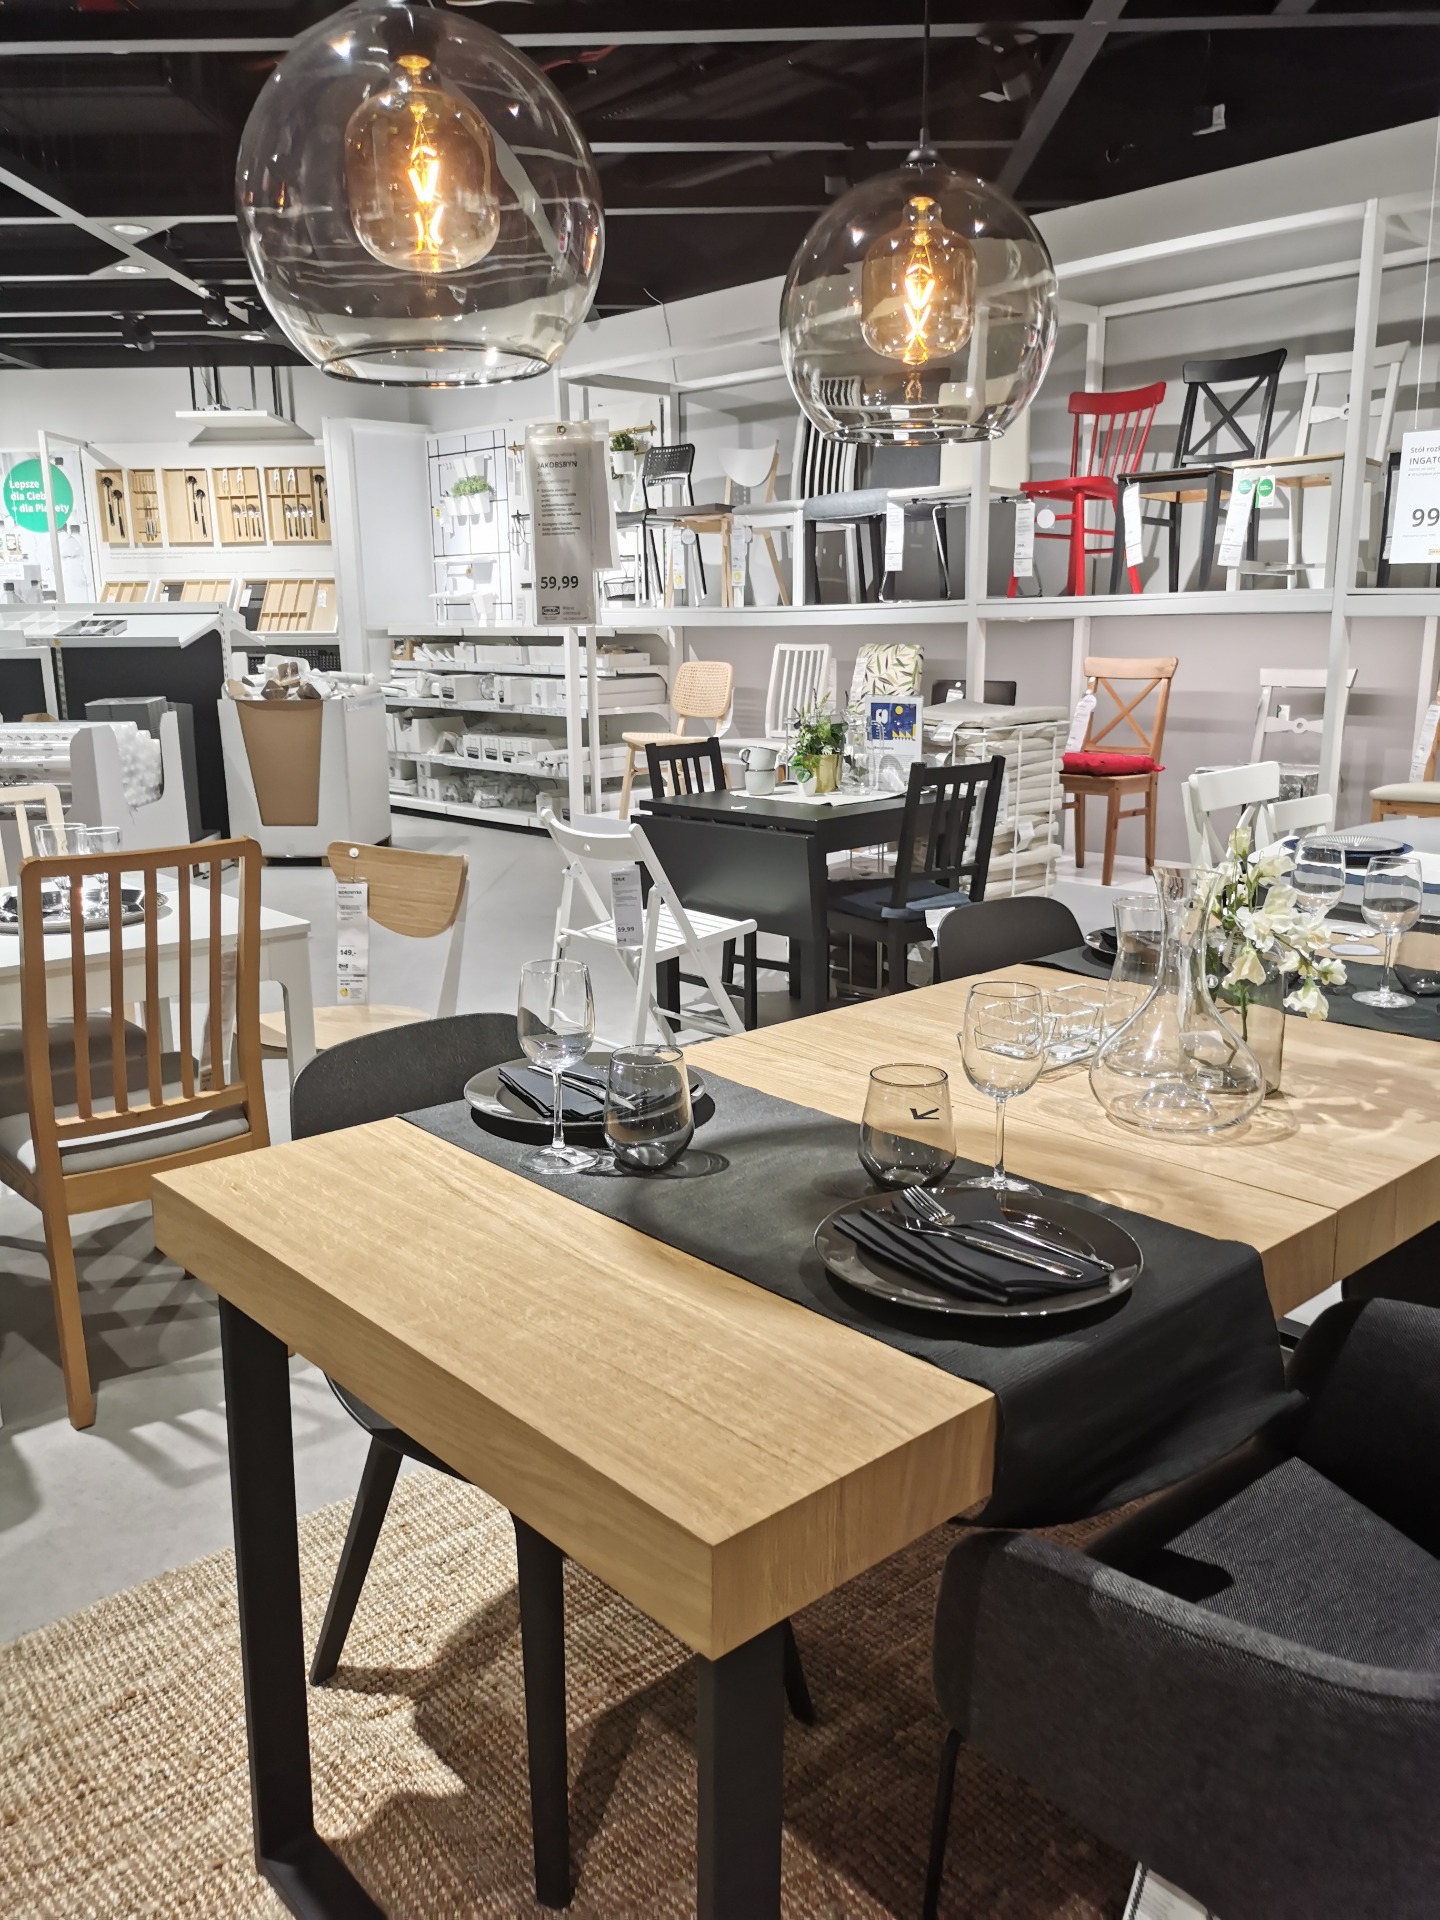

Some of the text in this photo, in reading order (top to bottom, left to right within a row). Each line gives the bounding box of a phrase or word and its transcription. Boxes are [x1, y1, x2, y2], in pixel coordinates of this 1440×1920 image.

[536, 460, 578, 470] JAKOBSBYN
[9, 481, 39, 490] Lepsze
[10, 491, 47, 501] dla Cieb
[19, 503, 34, 513] dla
[35, 503, 70, 515] Plaety
[540, 575, 579, 591] 59,99
